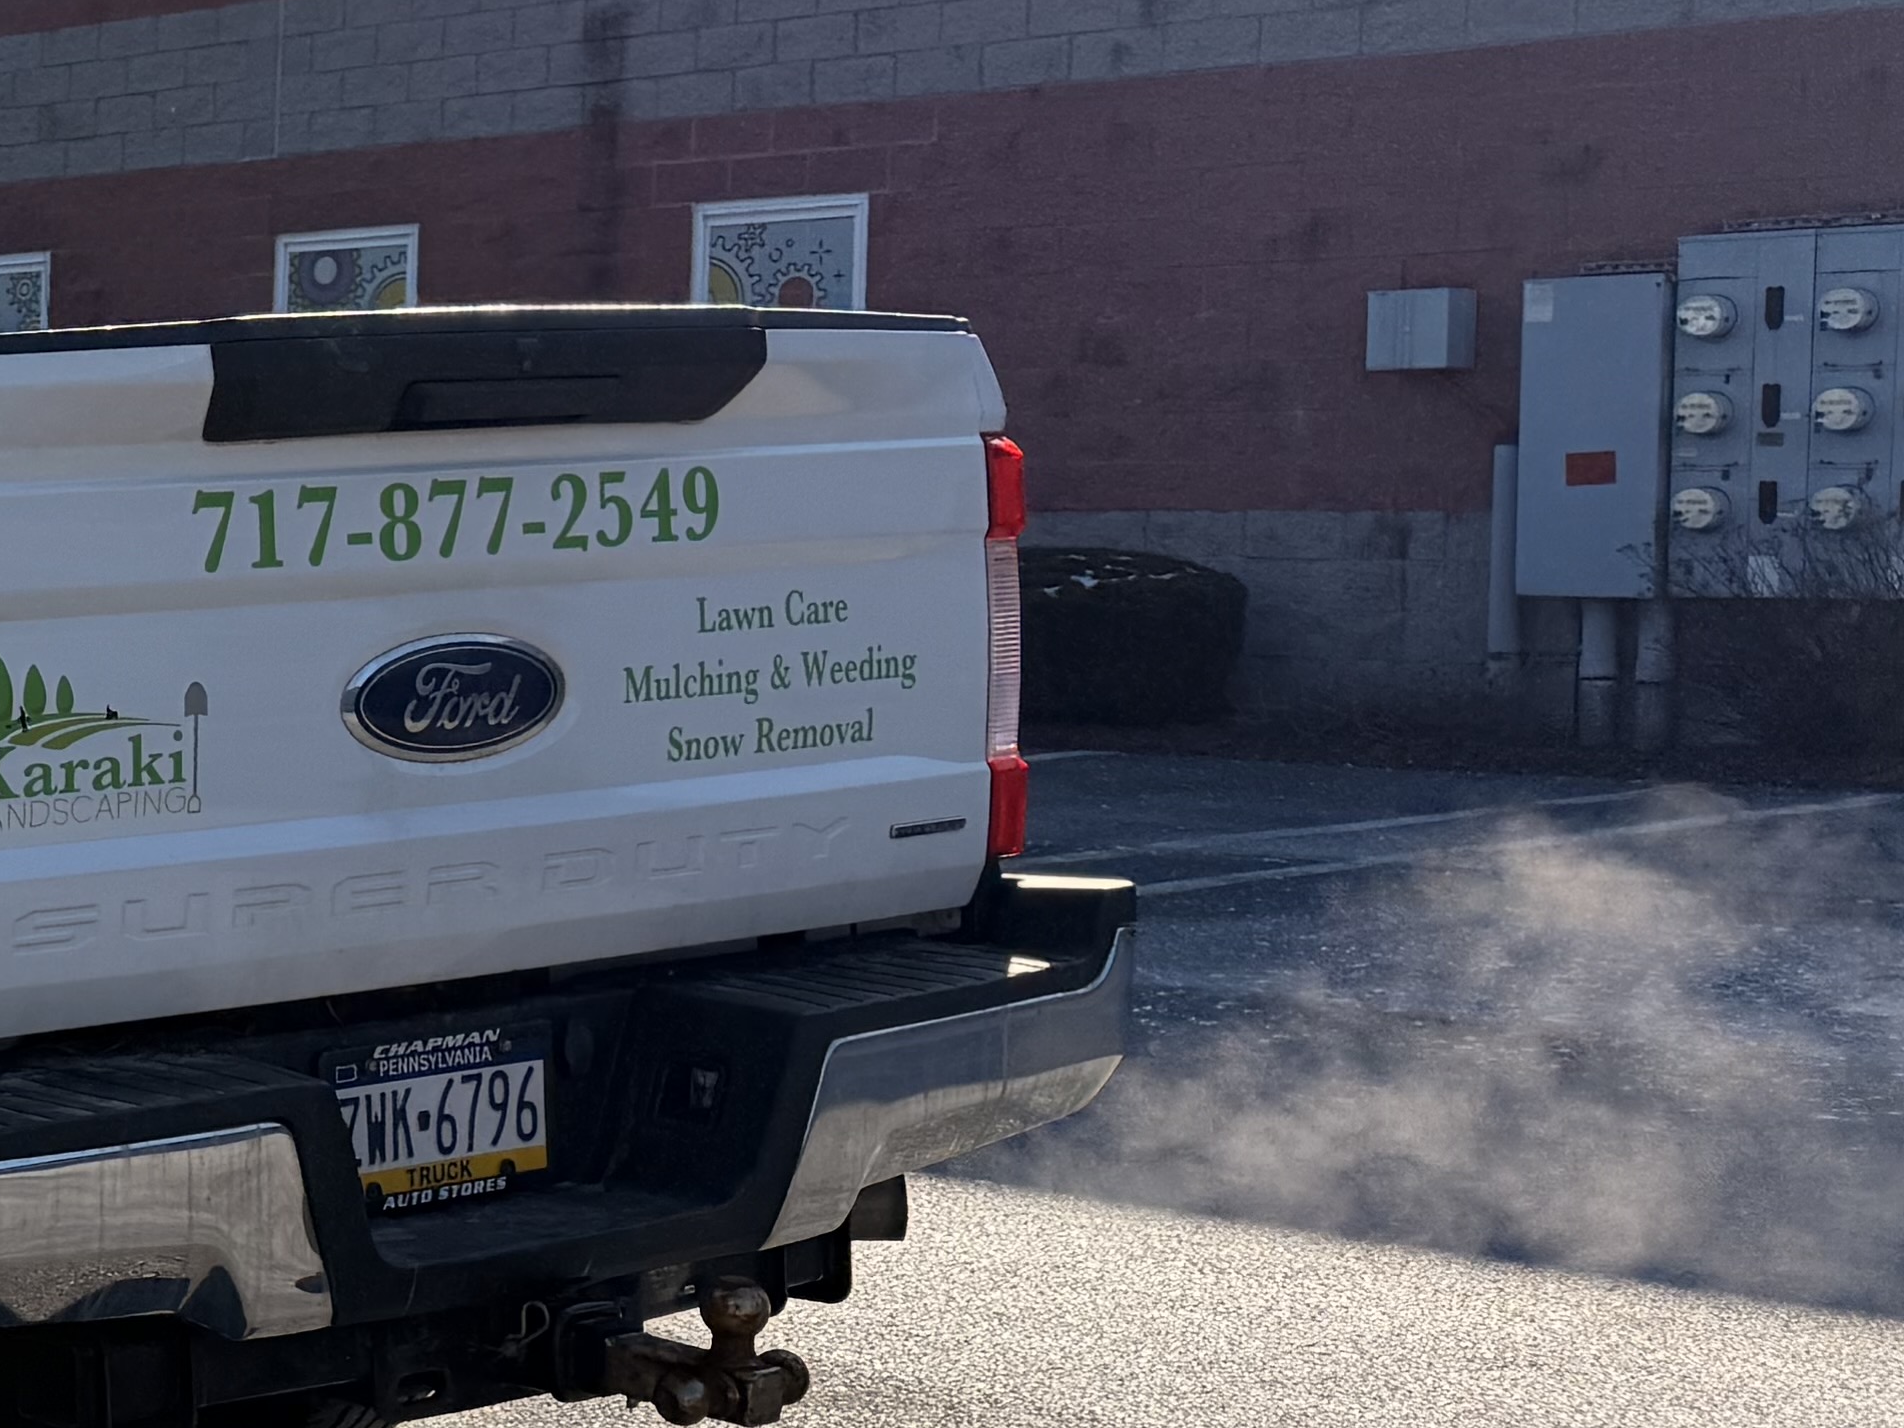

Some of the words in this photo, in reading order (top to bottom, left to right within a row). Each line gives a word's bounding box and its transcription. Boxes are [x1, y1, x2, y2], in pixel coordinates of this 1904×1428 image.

[192, 466, 720, 573] 717-877-2549
[696, 597, 774, 633] Lawn
[785, 590, 848, 625] Care
[404, 662, 523, 733] Ford
[623, 660, 760, 704] Mulching
[770, 654, 791, 690] &
[801, 645, 917, 689] Weeding
[667, 727, 744, 762] Snow
[754, 708, 874, 754] Removal
[11, 861, 504, 956] SUPER
[543, 816, 850, 893] DUTY
[373, 1028, 500, 1059] CHAPMAN
[379, 1045, 493, 1077] PENNSYLVANIA
[383, 1189, 432, 1211] AUTO
[438, 1177, 507, 1201] STORES
[406, 1160, 473, 1188] TRUCK
